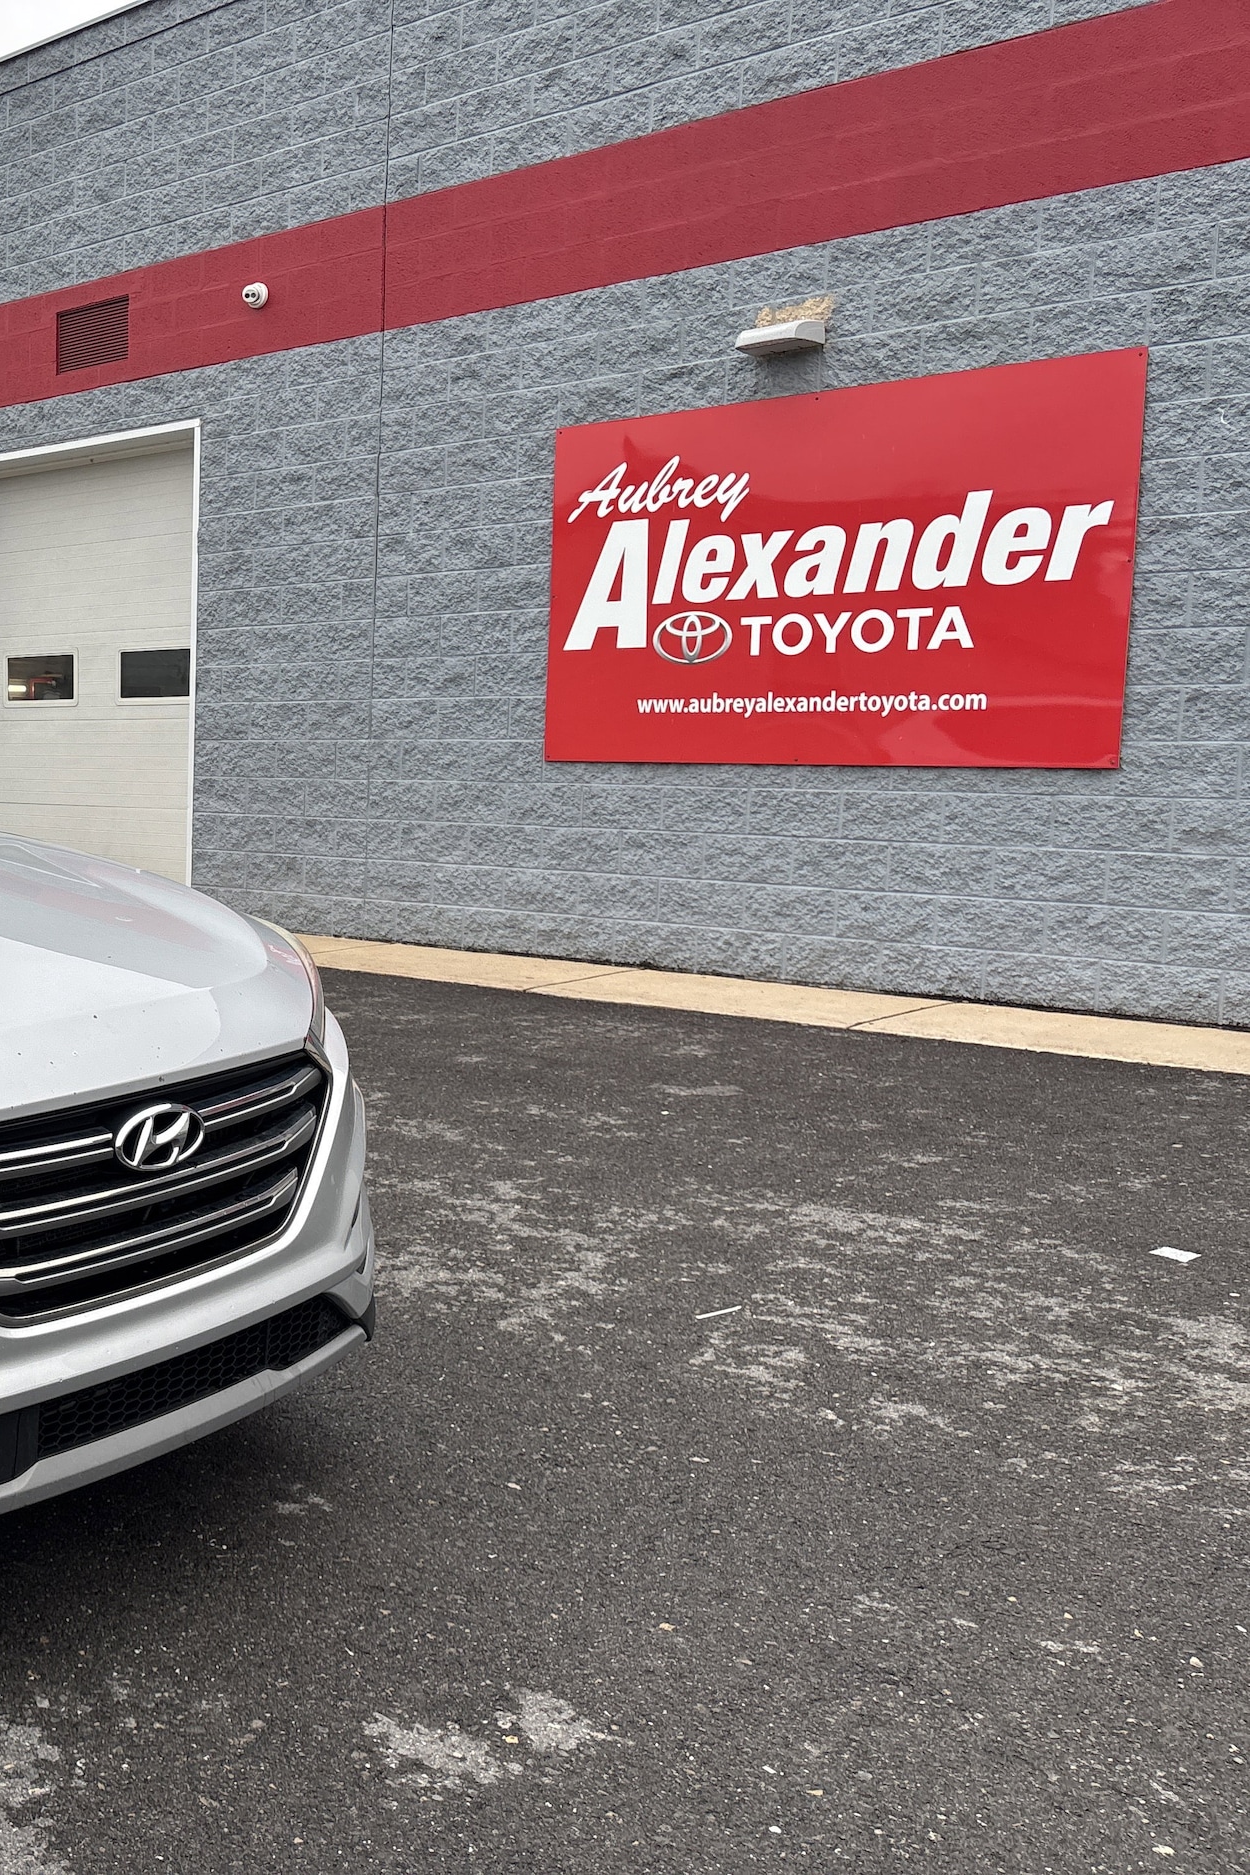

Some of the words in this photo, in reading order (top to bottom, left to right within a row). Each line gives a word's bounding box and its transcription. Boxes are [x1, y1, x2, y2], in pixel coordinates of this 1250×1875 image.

[567, 455, 750, 524] Aubrey
[562, 489, 1115, 651] Alexander
[741, 605, 975, 656] TOYOTA
[637, 690, 988, 719] www.aubreyalexandertoyota.com
